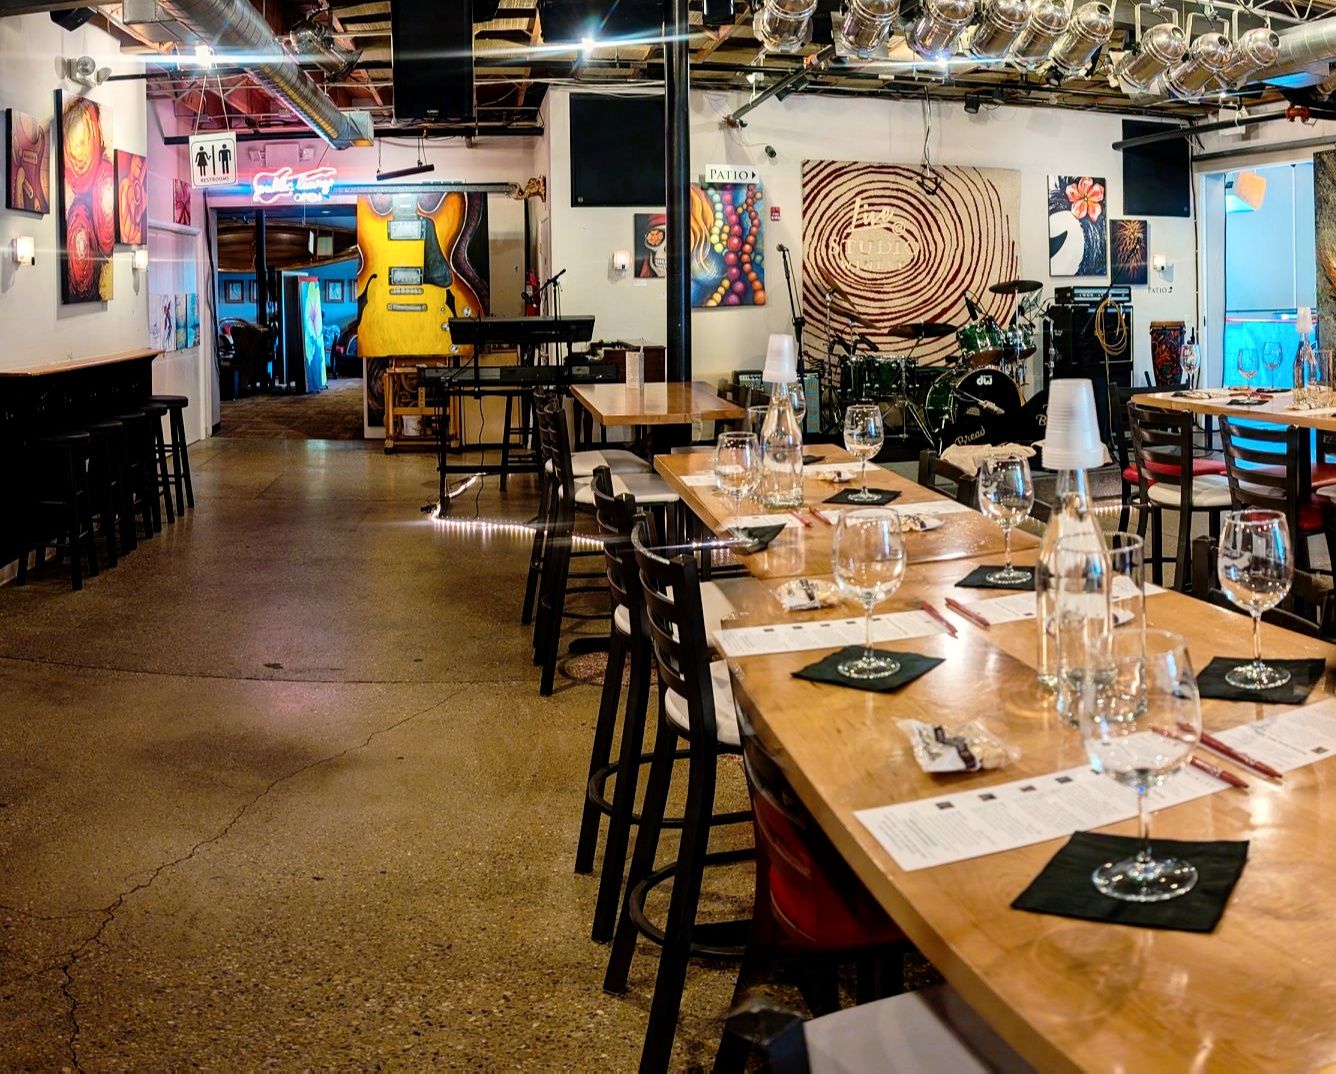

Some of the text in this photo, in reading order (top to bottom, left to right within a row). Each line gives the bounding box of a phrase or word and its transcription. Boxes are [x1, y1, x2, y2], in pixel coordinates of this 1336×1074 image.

[200, 175, 230, 184] RESTROOMS
[710, 168, 749, 180] PATIO
[829, 237, 920, 256] STUDIO
[1147, 286, 1167, 294] PATIO
[955, 425, 986, 445] Bread
